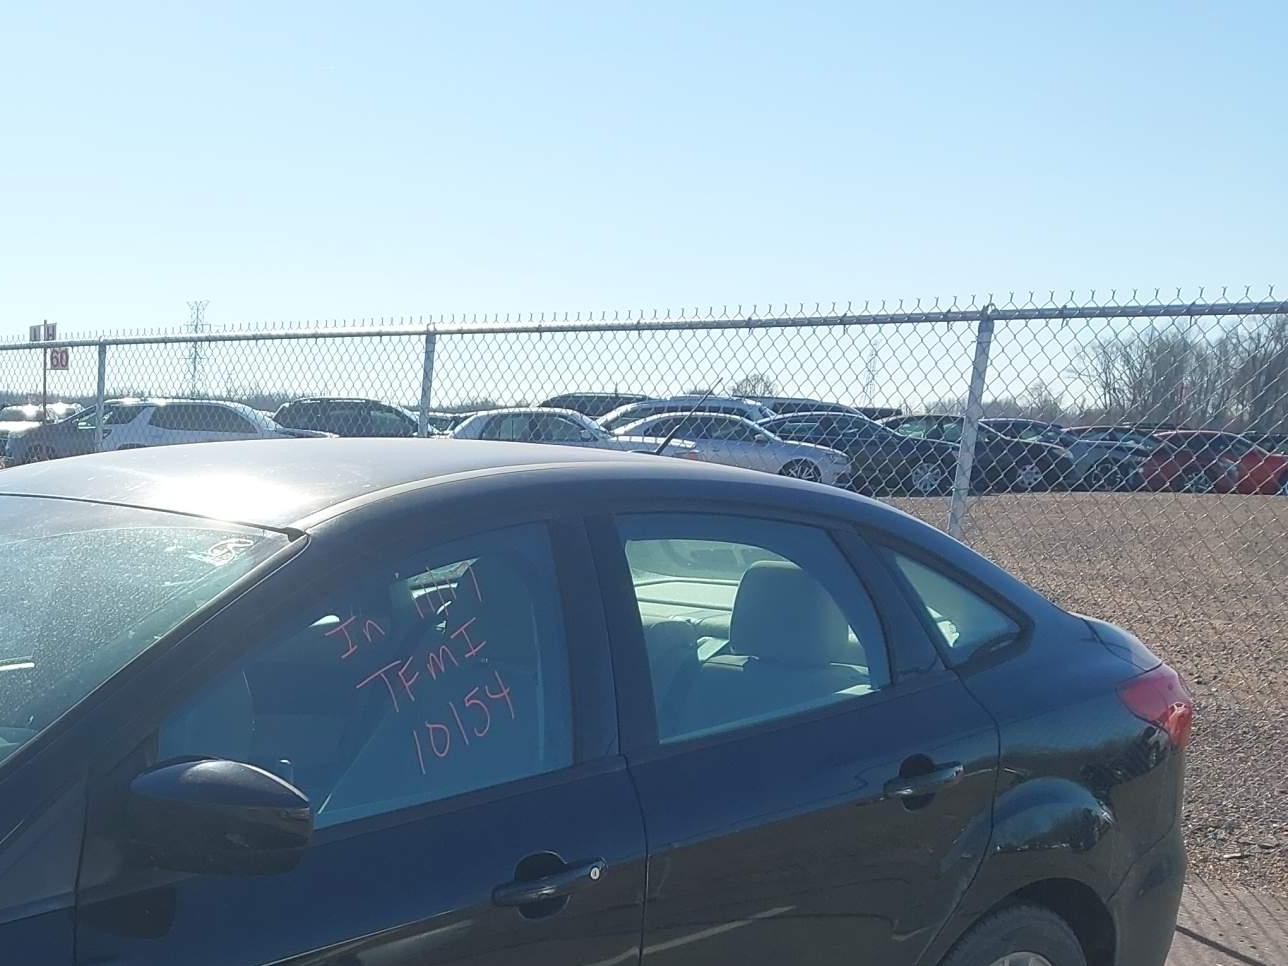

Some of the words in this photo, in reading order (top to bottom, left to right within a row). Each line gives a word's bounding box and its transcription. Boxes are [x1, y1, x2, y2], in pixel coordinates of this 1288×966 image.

[50, 349, 69, 369] 60
[324, 615, 385, 659] In
[413, 670, 515, 775] 10154
